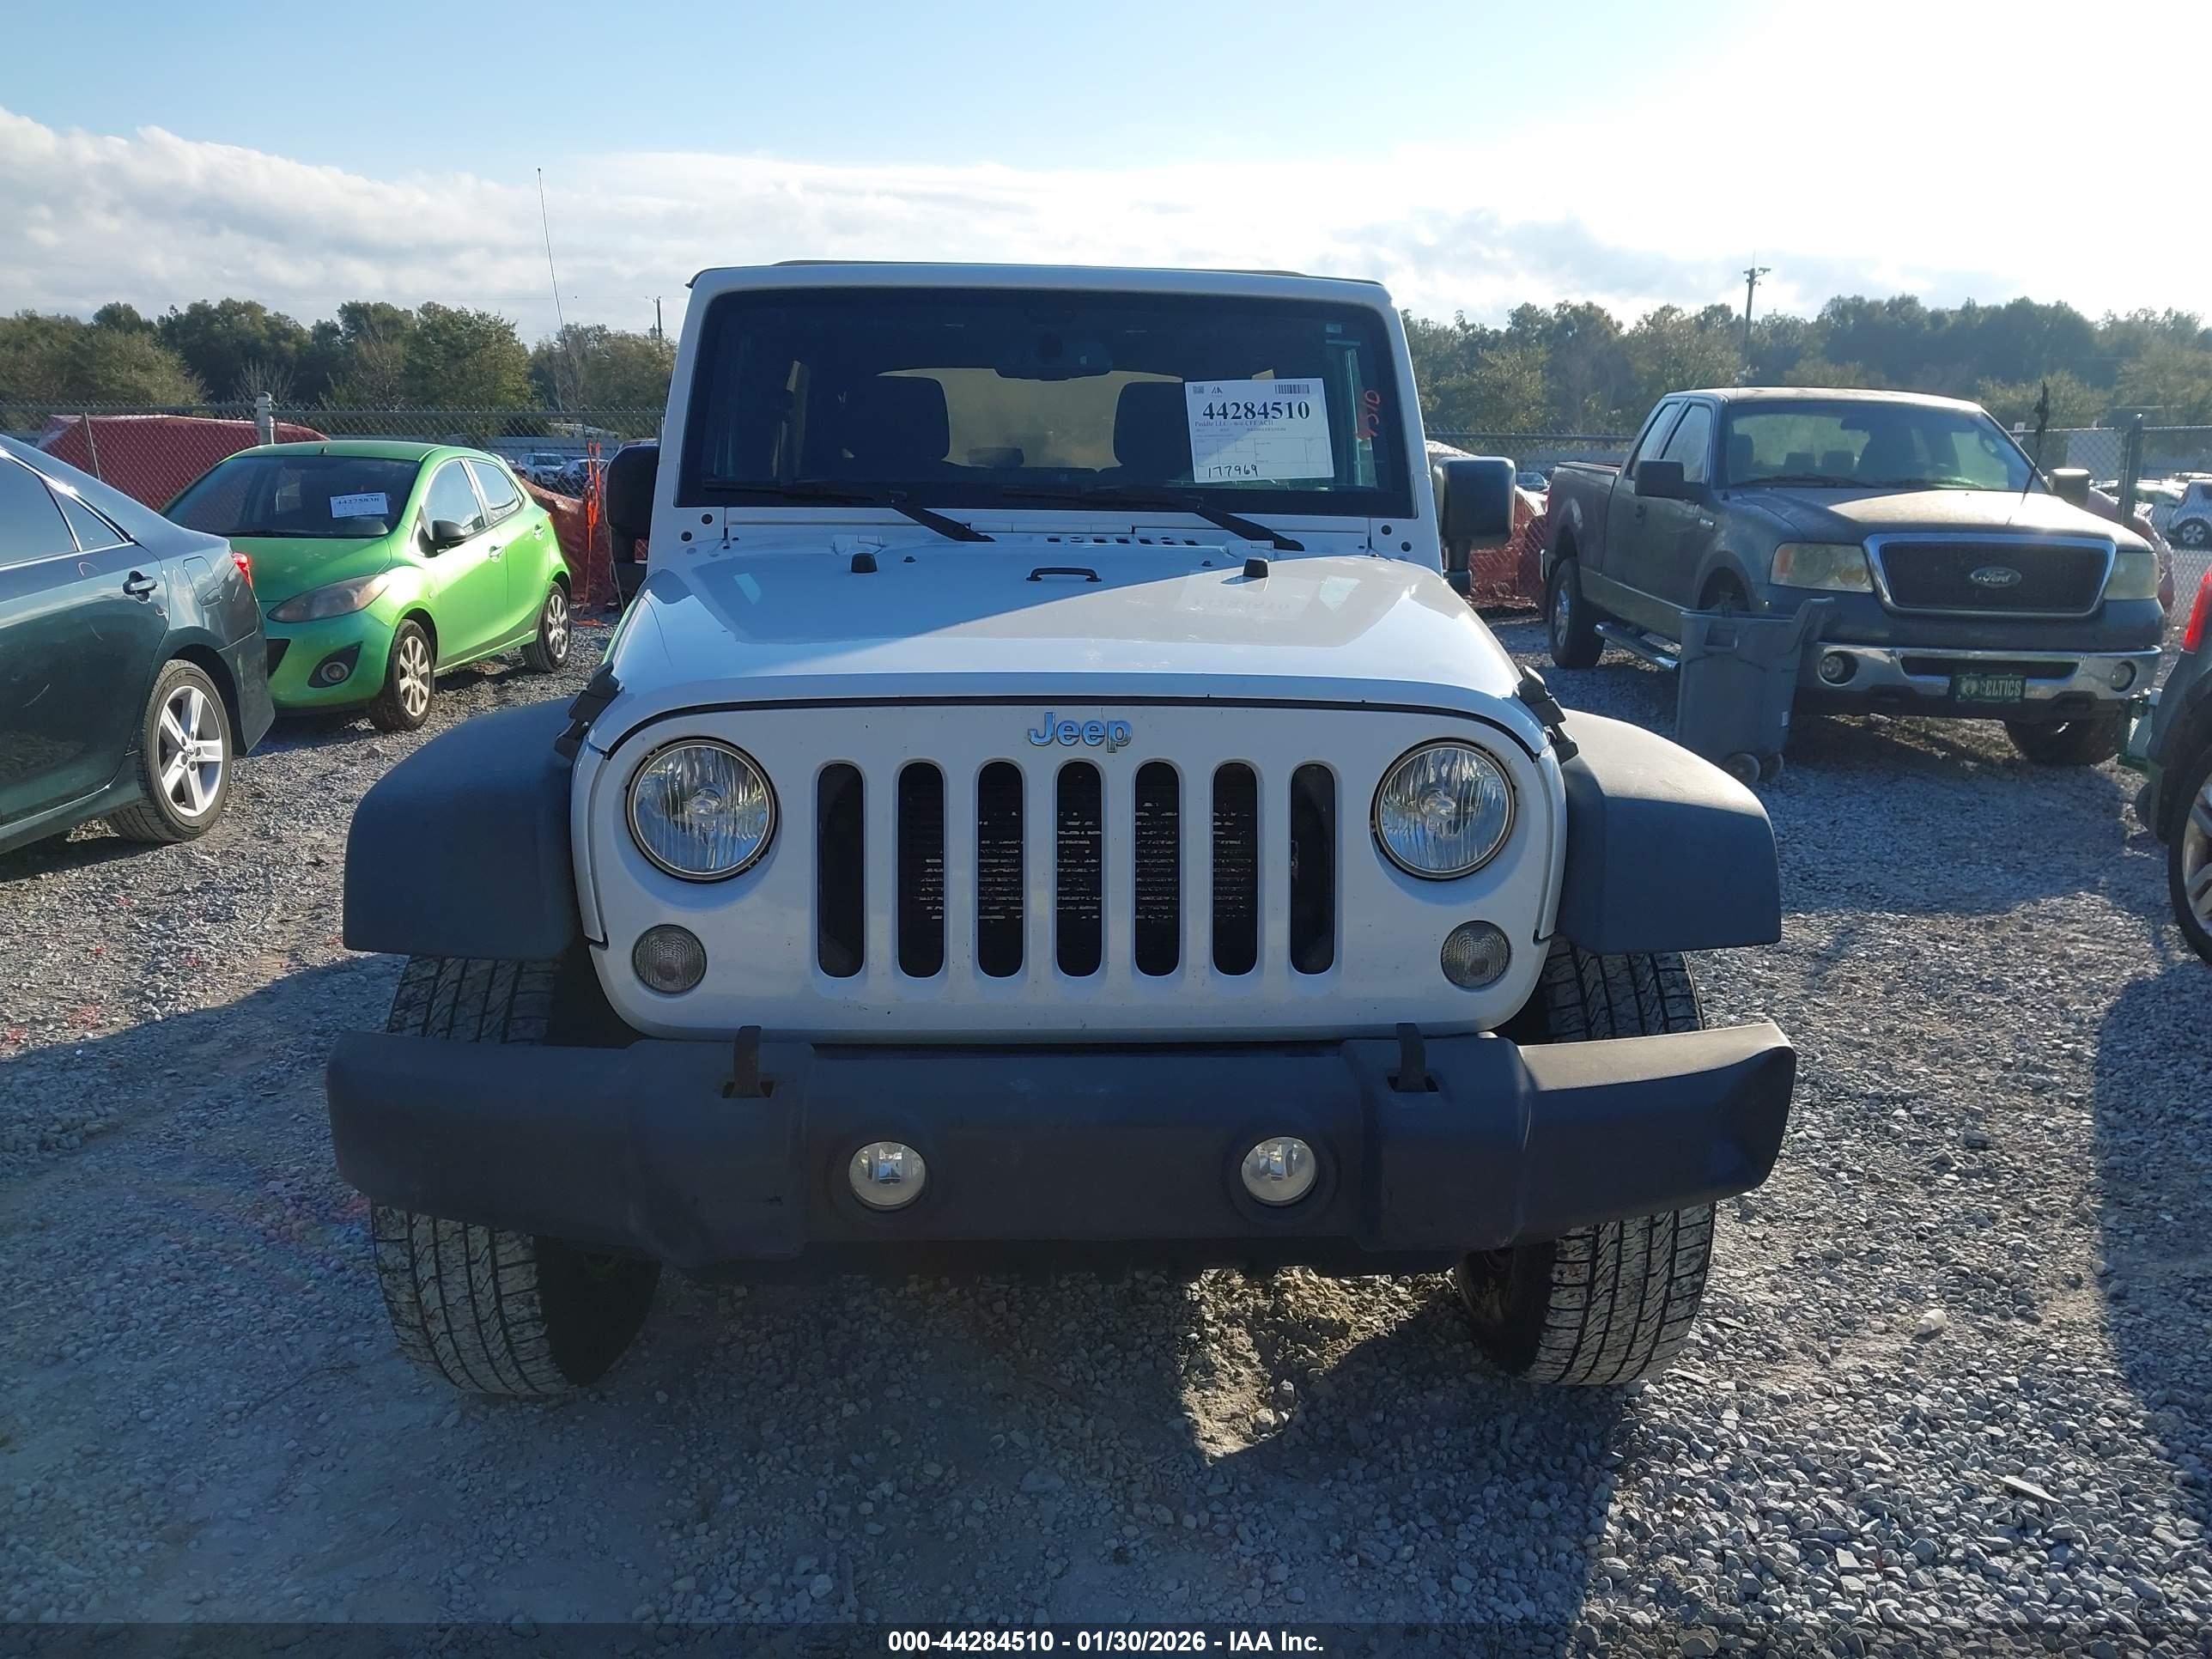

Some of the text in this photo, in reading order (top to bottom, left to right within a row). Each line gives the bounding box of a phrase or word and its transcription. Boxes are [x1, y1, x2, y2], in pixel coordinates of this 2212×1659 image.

[1202, 400, 1310, 420] 44284510
[1208, 464, 1258, 478] 177969
[1979, 679, 2021, 696] CELTICS
[1027, 711, 1133, 753] Jeep
